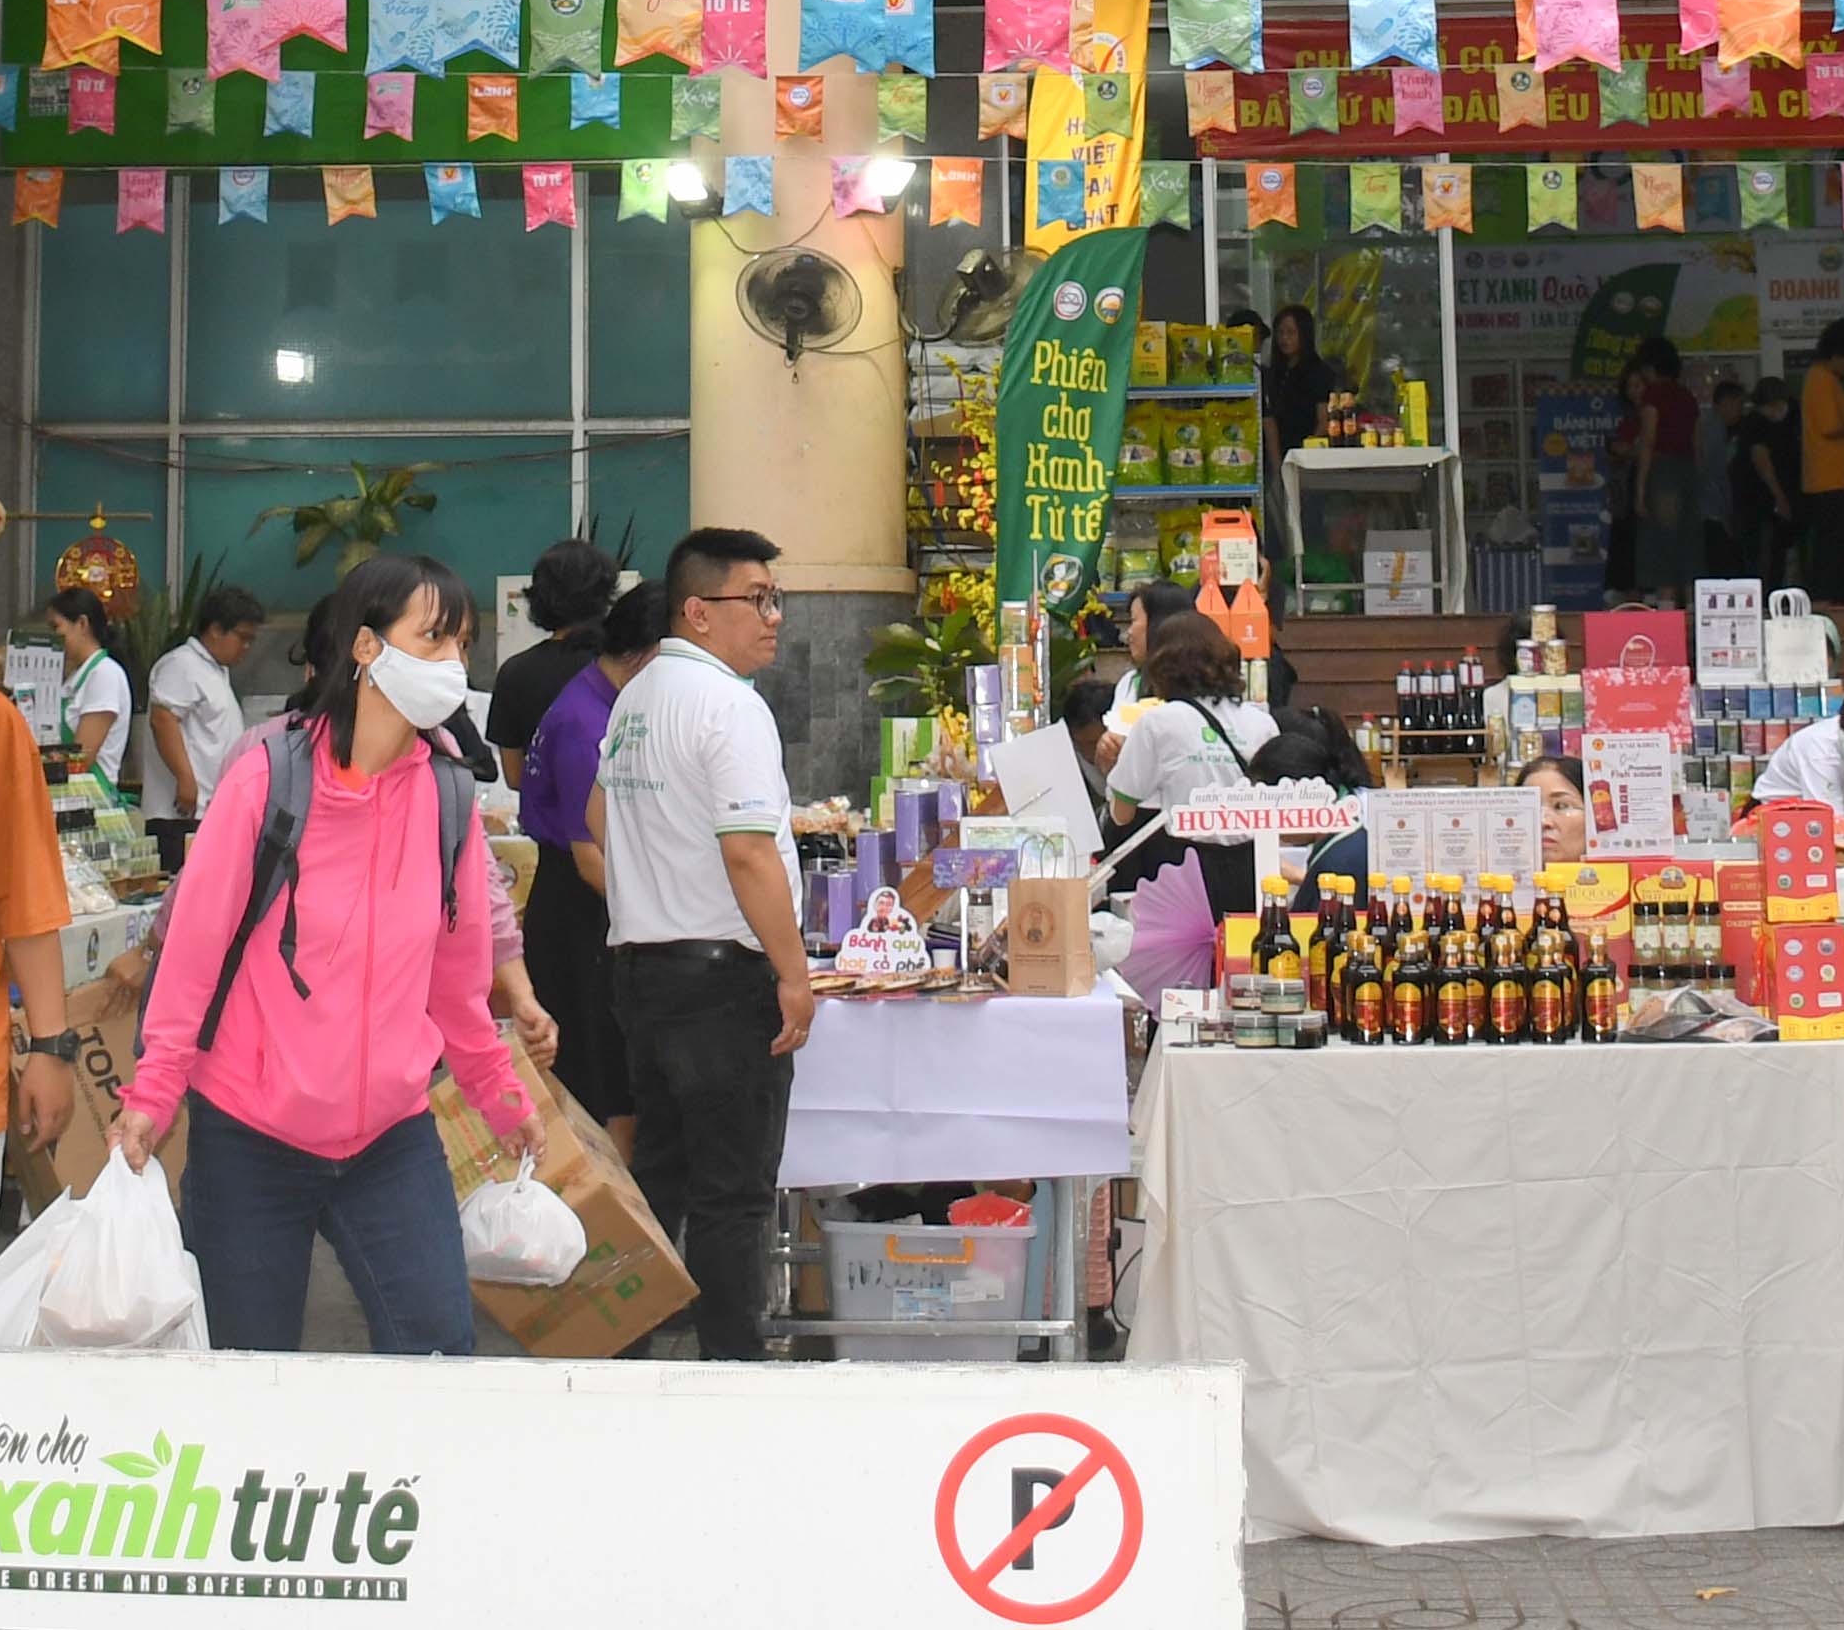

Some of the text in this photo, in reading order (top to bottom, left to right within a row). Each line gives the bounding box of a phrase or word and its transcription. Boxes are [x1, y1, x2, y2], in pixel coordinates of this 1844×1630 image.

[1030, 338, 1109, 395] Phiên
[1042, 400, 1093, 459] chợ
[1026, 496, 1067, 542] Tử
[1177, 804, 1353, 832] HUỲNH KHOA
[35, 1414, 89, 1474] chợ
[29, 1570, 104, 1591] GREEN
[121, 1573, 169, 1593] AND
[186, 1575, 246, 1595] SAFE
[263, 1577, 325, 1598] FOOD
[342, 1579, 400, 1599] FAIR
